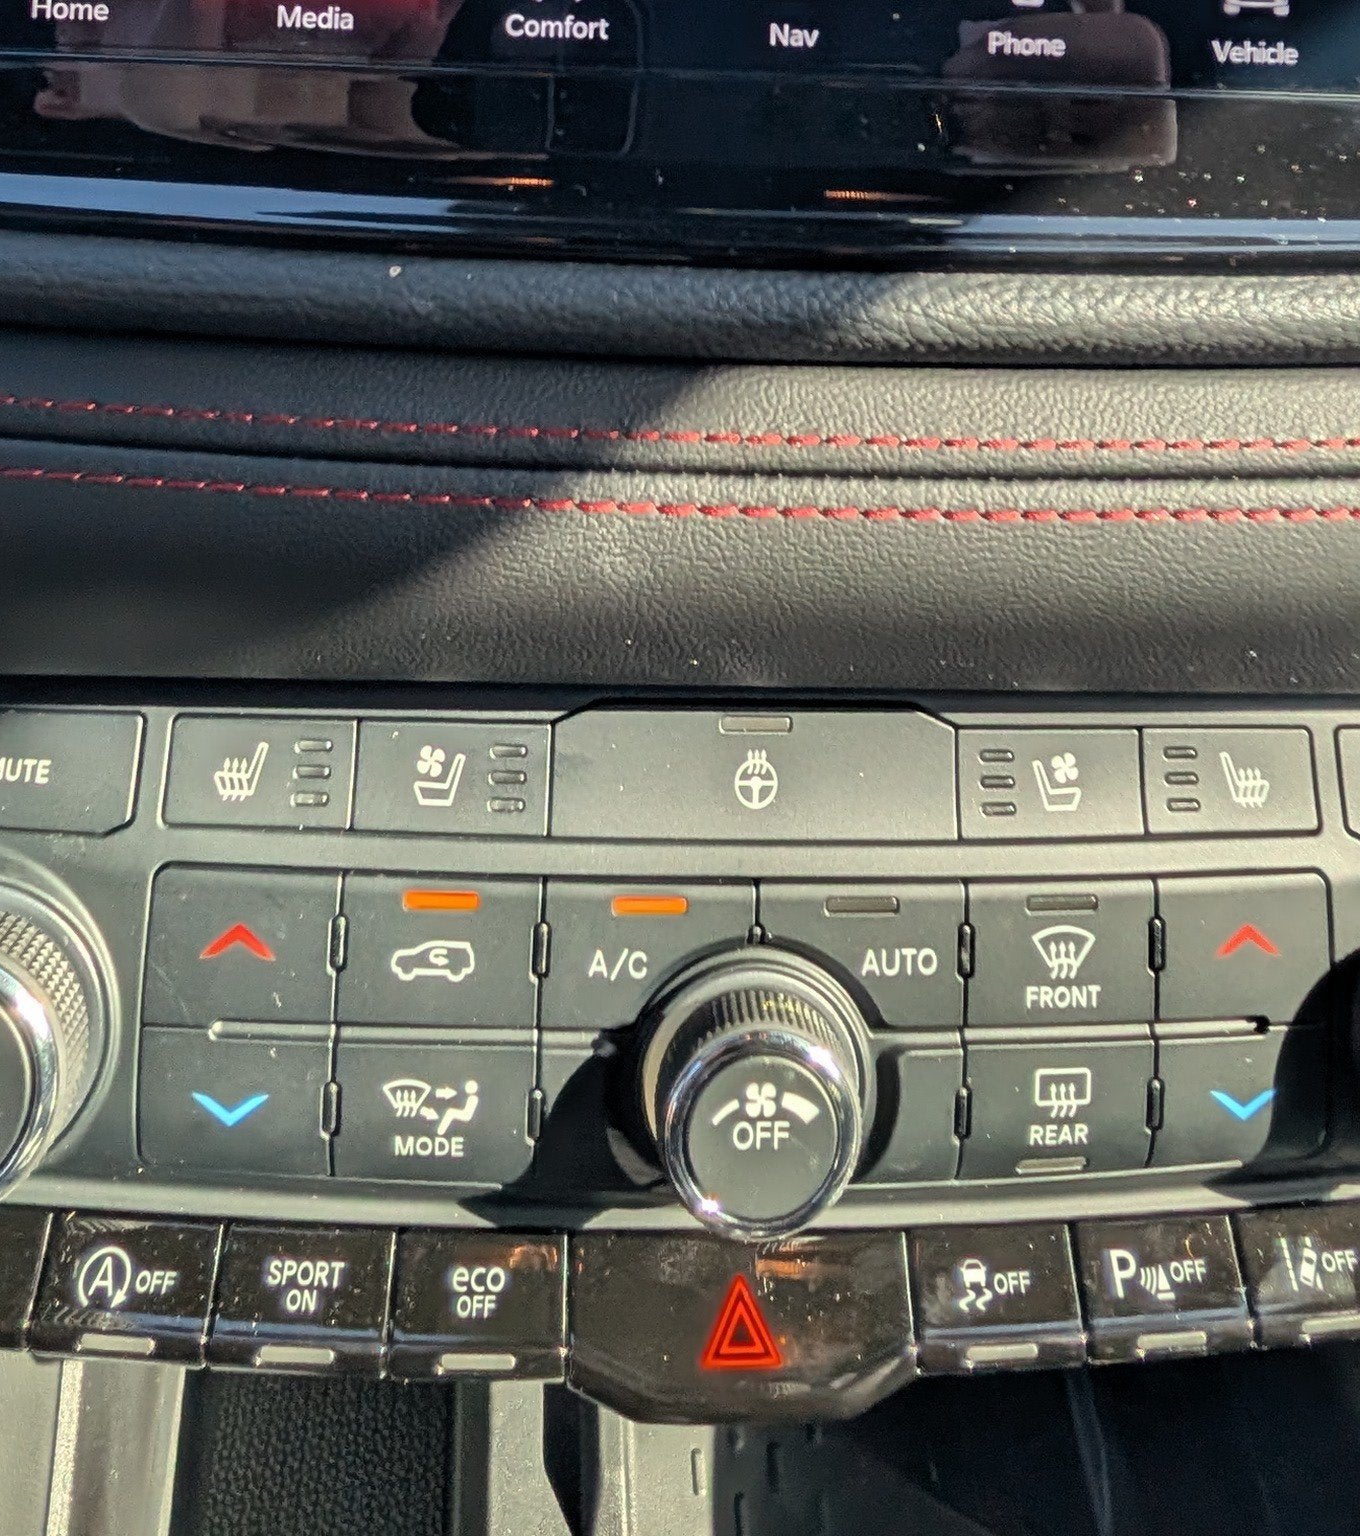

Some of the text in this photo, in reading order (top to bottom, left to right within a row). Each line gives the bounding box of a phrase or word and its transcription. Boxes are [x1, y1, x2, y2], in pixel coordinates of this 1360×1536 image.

[276, 4, 355, 32] Media
[504, 11, 610, 42] Comfort
[769, 22, 820, 50] Nav
[987, 30, 1066, 58] Phone
[1211, 39, 1299, 67] Vehicle
[587, 947, 650, 981] A/C
[861, 948, 939, 979] AUTO
[1025, 984, 1102, 1011] FRONT
[393, 1136, 465, 1158] MODE
[731, 1119, 791, 1153] OFF
[1029, 1124, 1088, 1148] REAR
[266, 1260, 345, 1288] SPORT
[1169, 1259, 1207, 1284] OFF
[1320, 1251, 1359, 1276] OFF
[135, 1270, 177, 1296] OFF
[452, 1266, 506, 1293] eco
[993, 1270, 1031, 1296] OFF
[286, 1289, 318, 1314] ON
[456, 1294, 497, 1319] OFF
